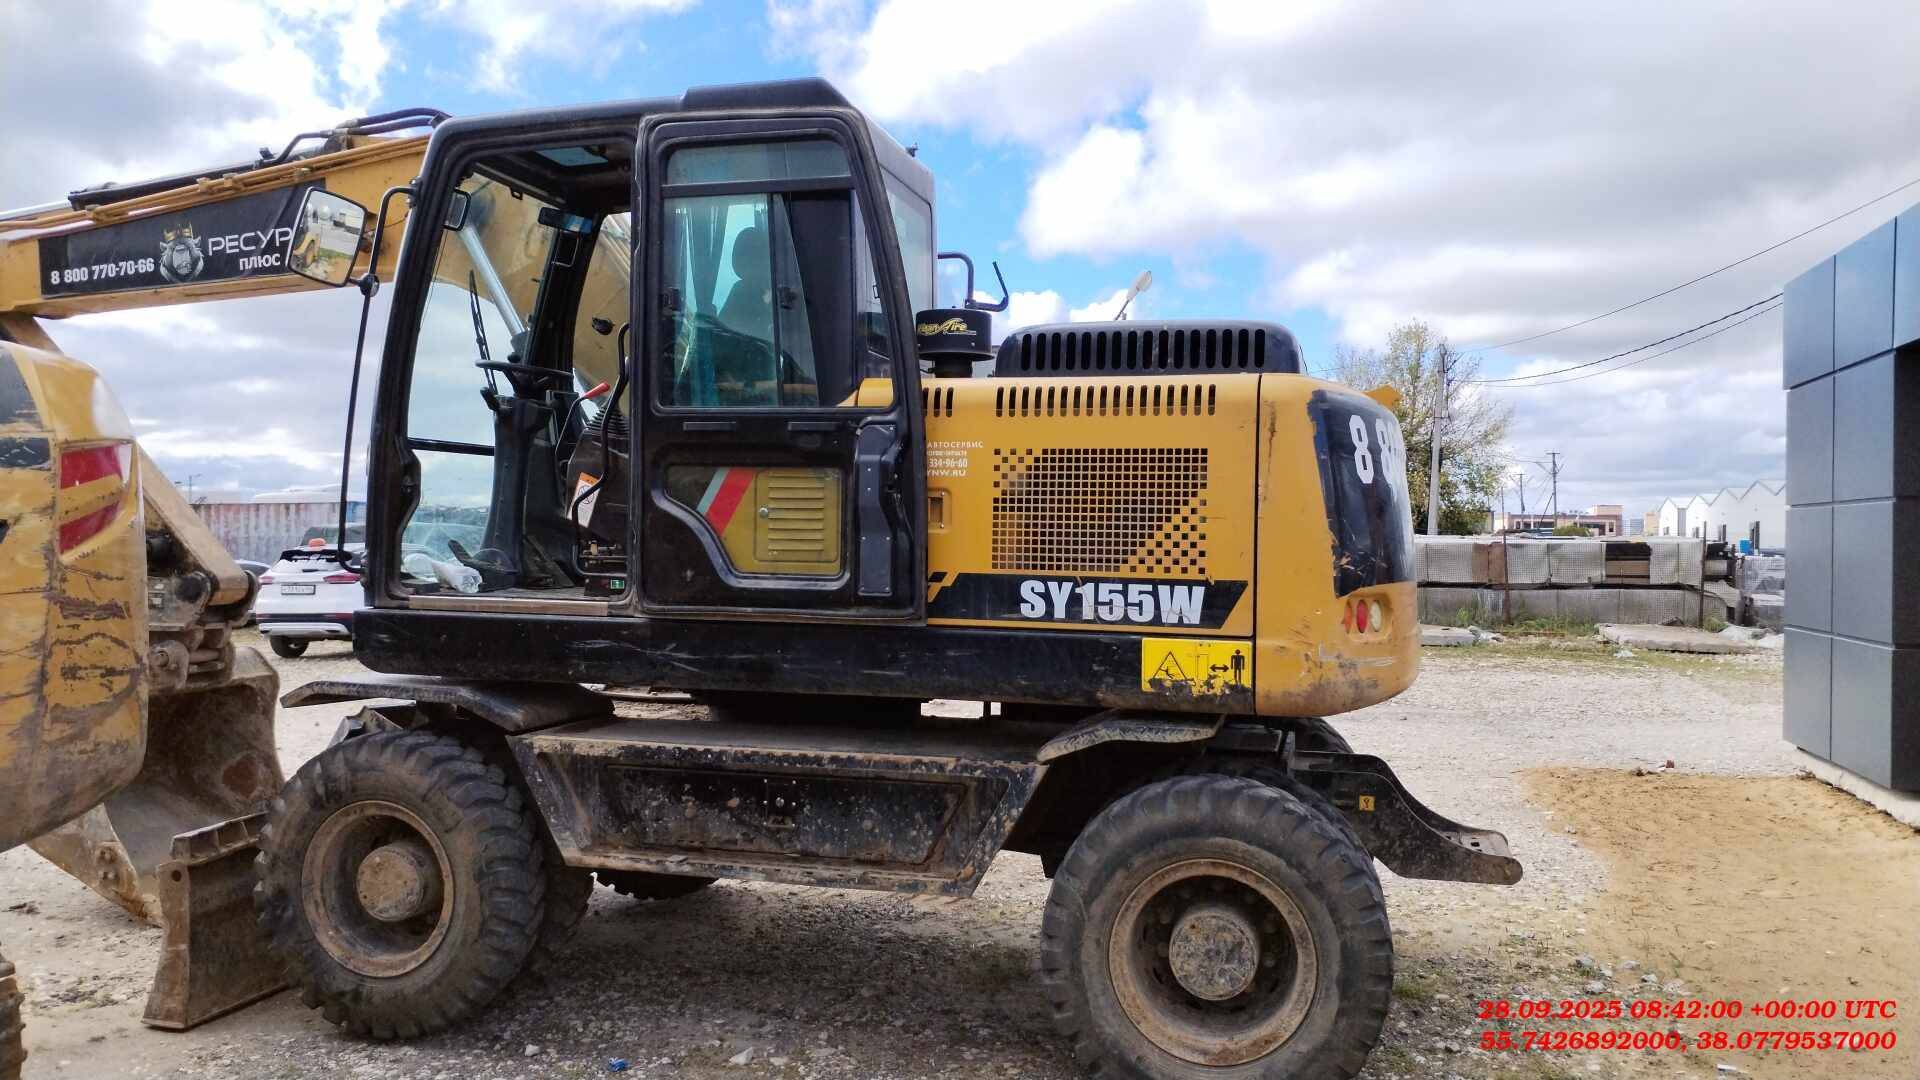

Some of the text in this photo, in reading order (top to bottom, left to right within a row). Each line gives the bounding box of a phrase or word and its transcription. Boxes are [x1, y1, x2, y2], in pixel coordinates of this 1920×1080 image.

[51, 258, 154, 285] 8 800 770-70-66
[239, 254, 281, 270] ПЛЮС
[1349, 415, 1375, 484] 8
[1020, 579, 1206, 625] SY155W
